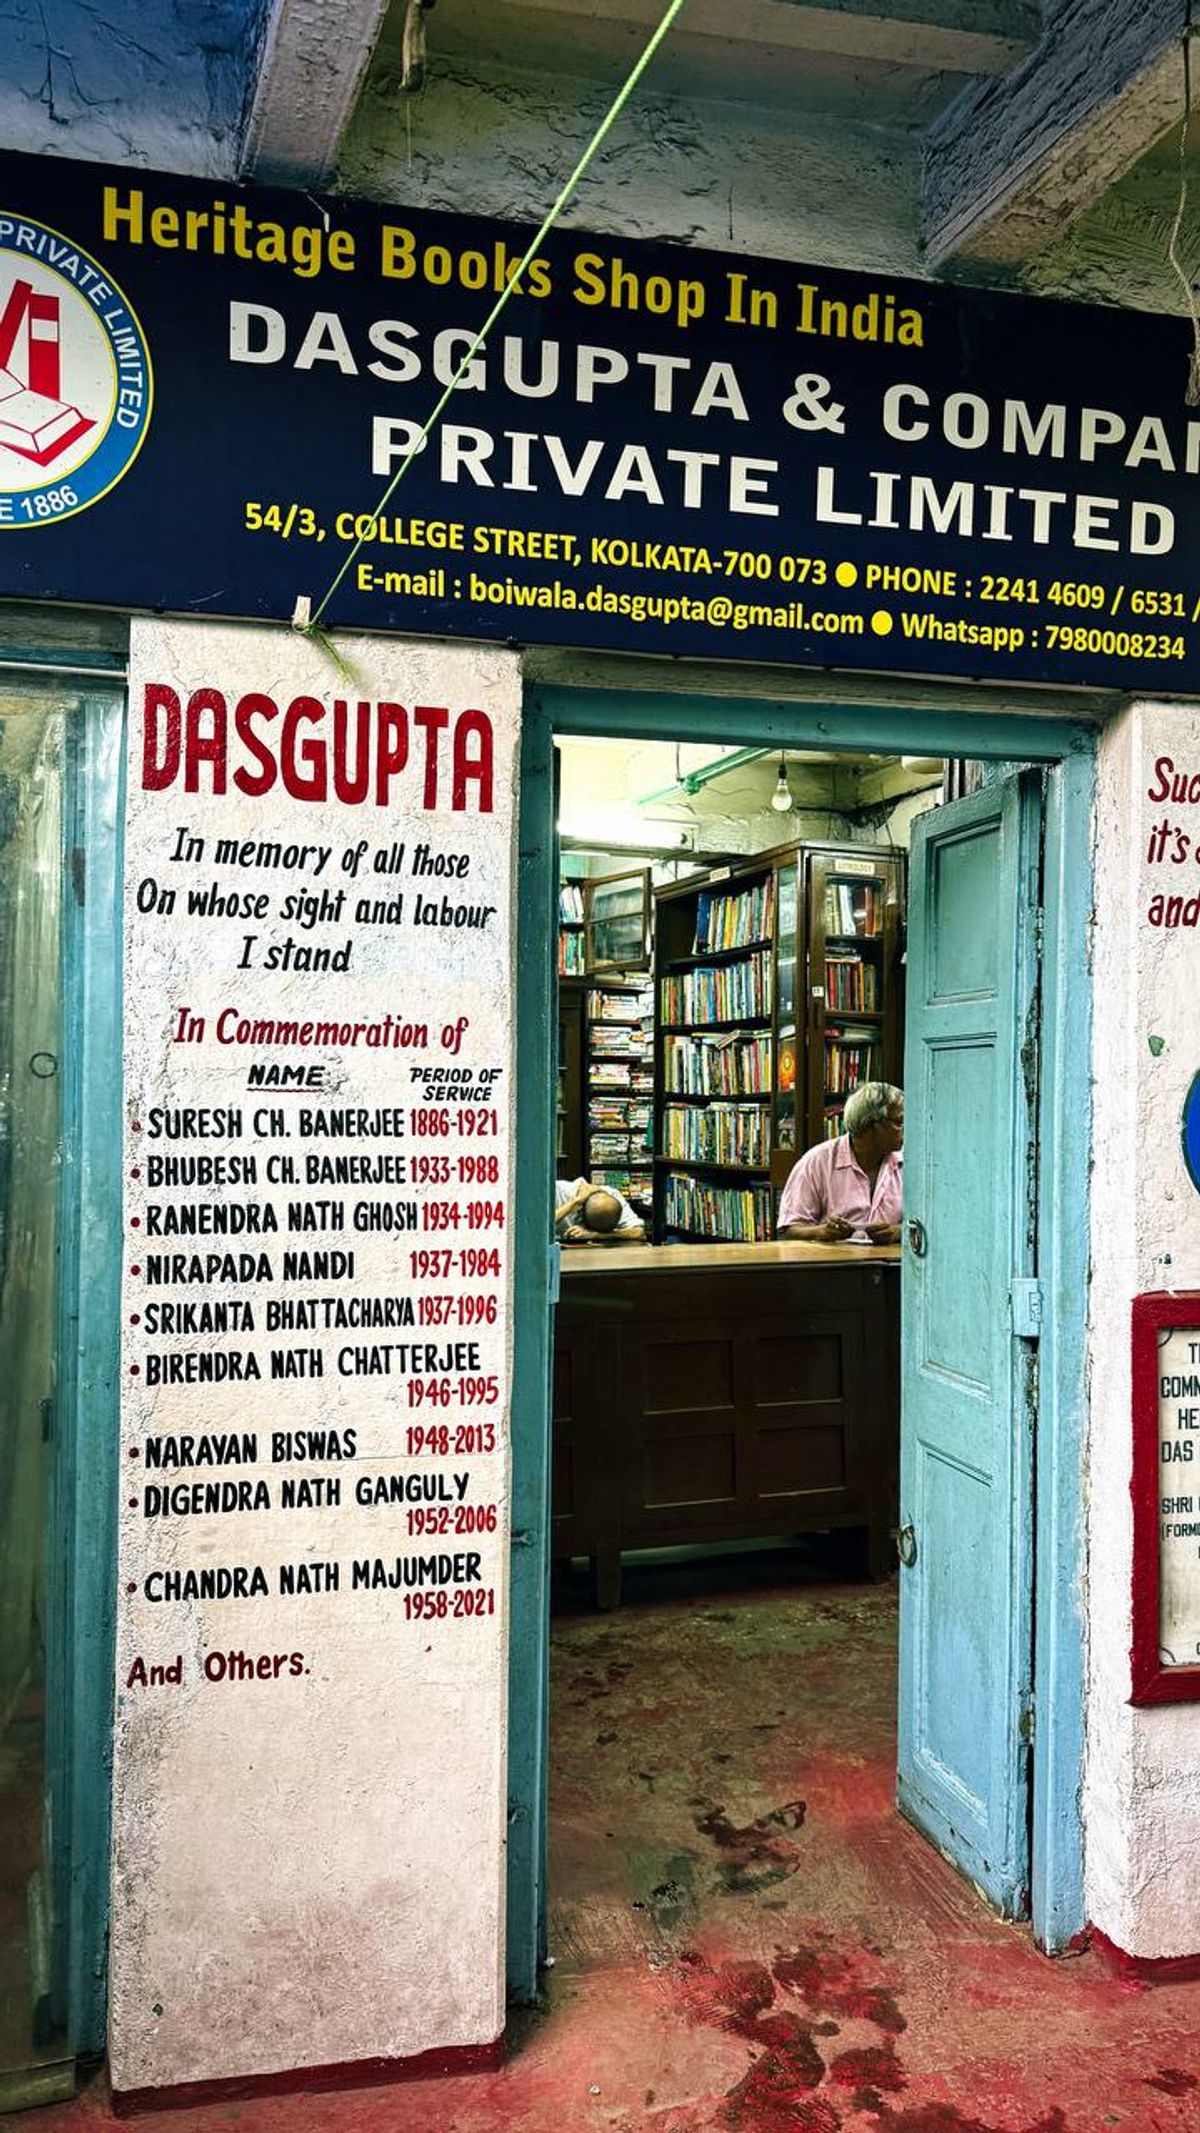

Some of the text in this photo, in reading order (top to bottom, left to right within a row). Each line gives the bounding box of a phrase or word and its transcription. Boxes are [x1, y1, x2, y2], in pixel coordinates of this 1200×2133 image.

[103, 187, 924, 347] Heritage Books Shop In India
[0, 219, 143, 430] PRIVATE LIMITED
[229, 301, 750, 422] DASGUPTA
[782, 373, 845, 435] &
[21, 485, 78, 519] 1886
[371, 415, 1176, 556] PRIVATE LIMITED
[245, 503, 326, 542] 54/3,
[335, 513, 465, 550] COLLEGE
[473, 527, 581, 567] STREET,
[591, 538, 772, 580] KOLKATA-700
[779, 556, 827, 585] 073
[866, 564, 956, 597] PHONE
[980, 575, 1039, 604] 2241
[1047, 581, 1105, 609] 4609
[1131, 590, 1186, 617] 6531
[357, 563, 445, 597] E-mail
[469, 572, 864, 635] boiwala.dasgupta@gmail.com
[902, 611, 1024, 652] Whatsapp
[1045, 625, 1186, 660] 7980008234
[142, 684, 494, 813] DASGUPTA
[1148, 756, 1200, 804] Suc
[169, 827, 471, 879] In memory of all those
[1147, 818, 1191, 865] it's
[136, 878, 498, 929] On whose sight and labour
[1148, 889, 1200, 929] and
[236, 936, 353, 973] I stand
[173, 1008, 470, 1055] In Commemoration of
[247, 1064, 326, 1087] NAME
[409, 1067, 503, 1084] PERIOD OF
[422, 1085, 492, 1102] SERVICE
[146, 1107, 499, 1140] SURESH CH. BANERJEE 1886-1921
[146, 1155, 500, 1187] BHUBESH CH. BANERJEE 1933-1988
[145, 1201, 505, 1236] RANENDRA NATH GHOSH 1934-1994
[145, 1248, 502, 1285] NIRAPADA NANDI 1937-1984
[144, 1294, 498, 1335] SRIKANTA BHATTACHARYA 1937-1996
[145, 1342, 482, 1386] BIRENDRA NATH CHATTERJEE
[1188, 1342, 1200, 1365] T
[406, 1375, 500, 1408] 1946-1995
[144, 1423, 496, 1469] NARAYAN BISWAS 1948-2013
[1161, 1440, 1194, 1462] DAS
[143, 1472, 470, 1518] DIGENDRA NATH GANGULY
[1161, 1497, 1193, 1515] SHRI
[405, 1505, 498, 1537] 1952-2006
[143, 1552, 482, 1603] CHANDRA NATH MAJUMDER
[403, 1588, 495, 1620] 1958-2021
[126, 1650, 311, 1689] And Others.
